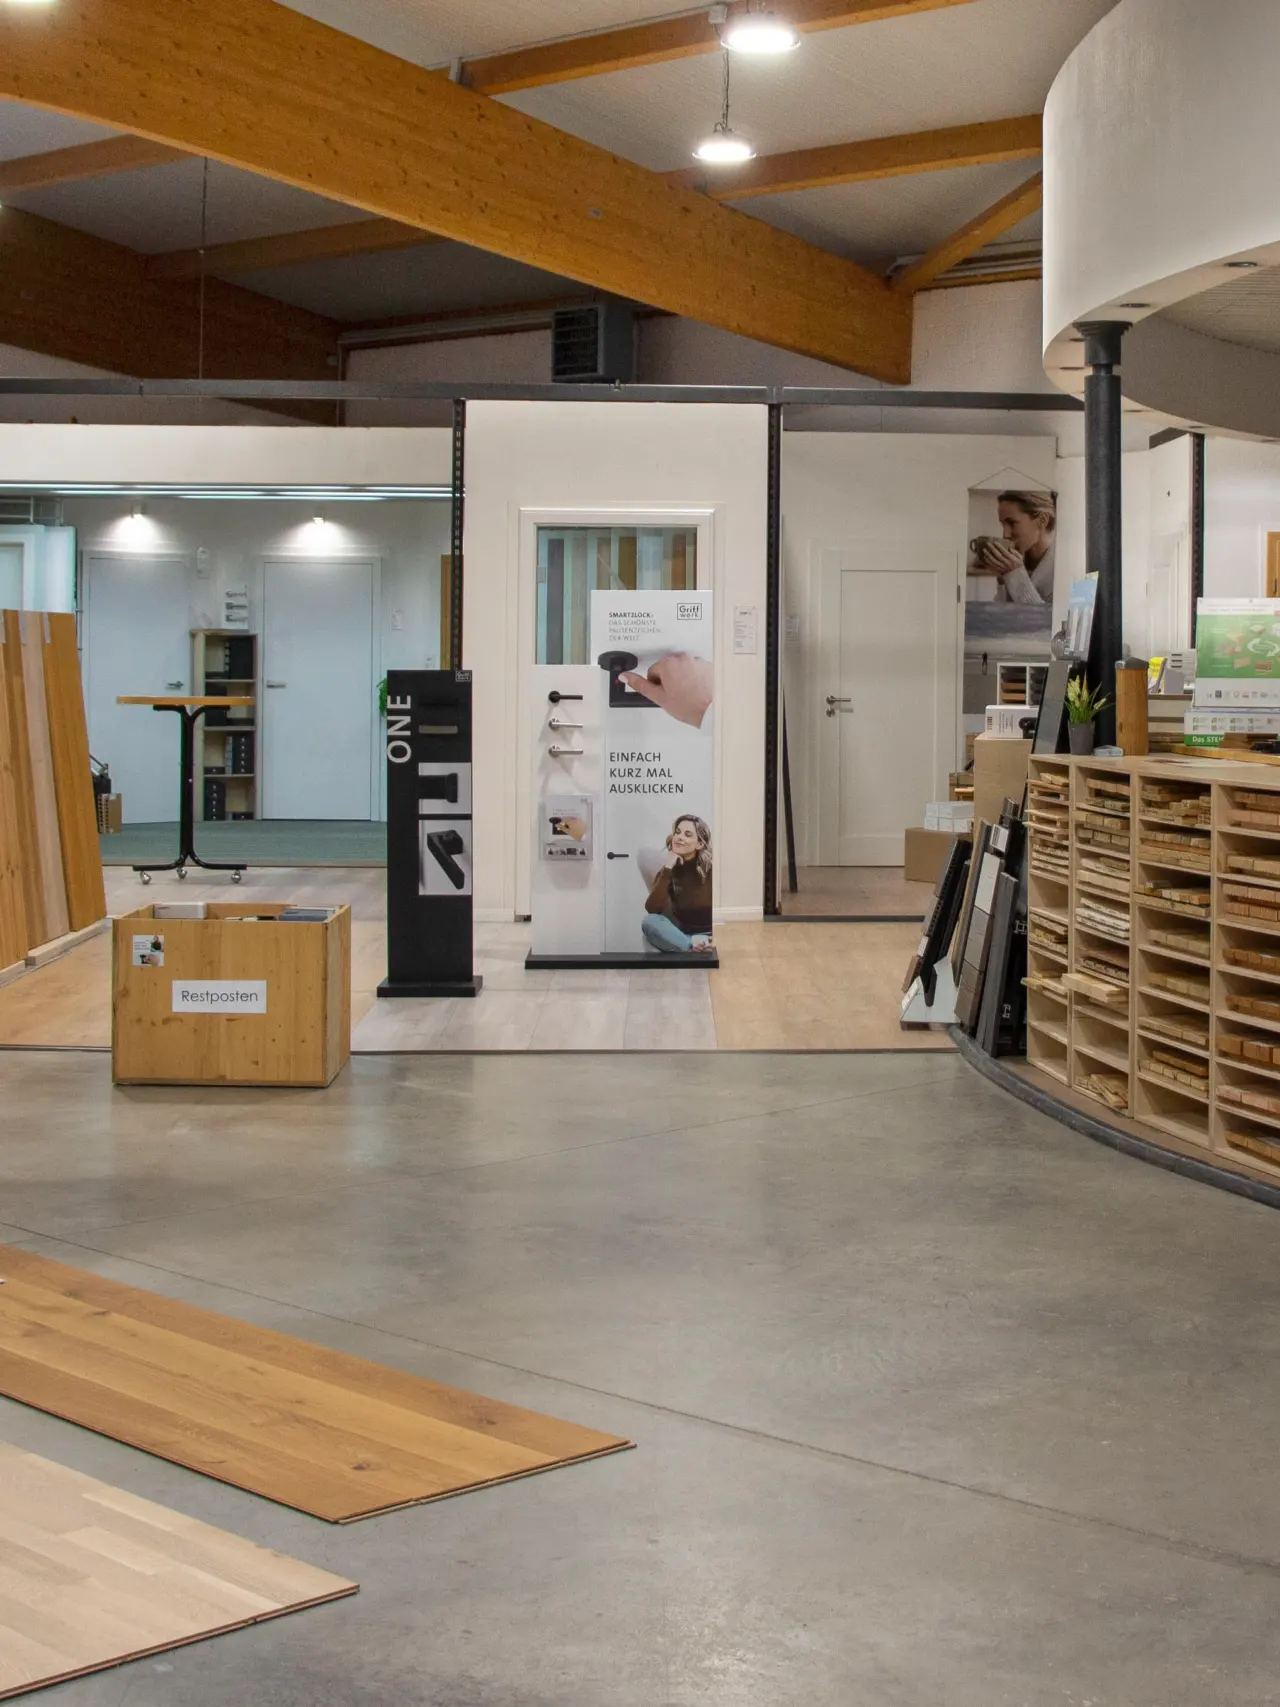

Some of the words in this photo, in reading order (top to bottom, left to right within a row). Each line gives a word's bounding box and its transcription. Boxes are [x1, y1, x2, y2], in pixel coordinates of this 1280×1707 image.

[679, 605, 700, 613] Griff
[387, 695, 412, 764] ONE
[609, 752, 661, 762] EINFACH
[609, 768, 642, 778] KURZ
[646, 768, 673, 778] MAL
[609, 784, 684, 794] AUSKLICKEN
[181, 990, 258, 1005] Restposten
